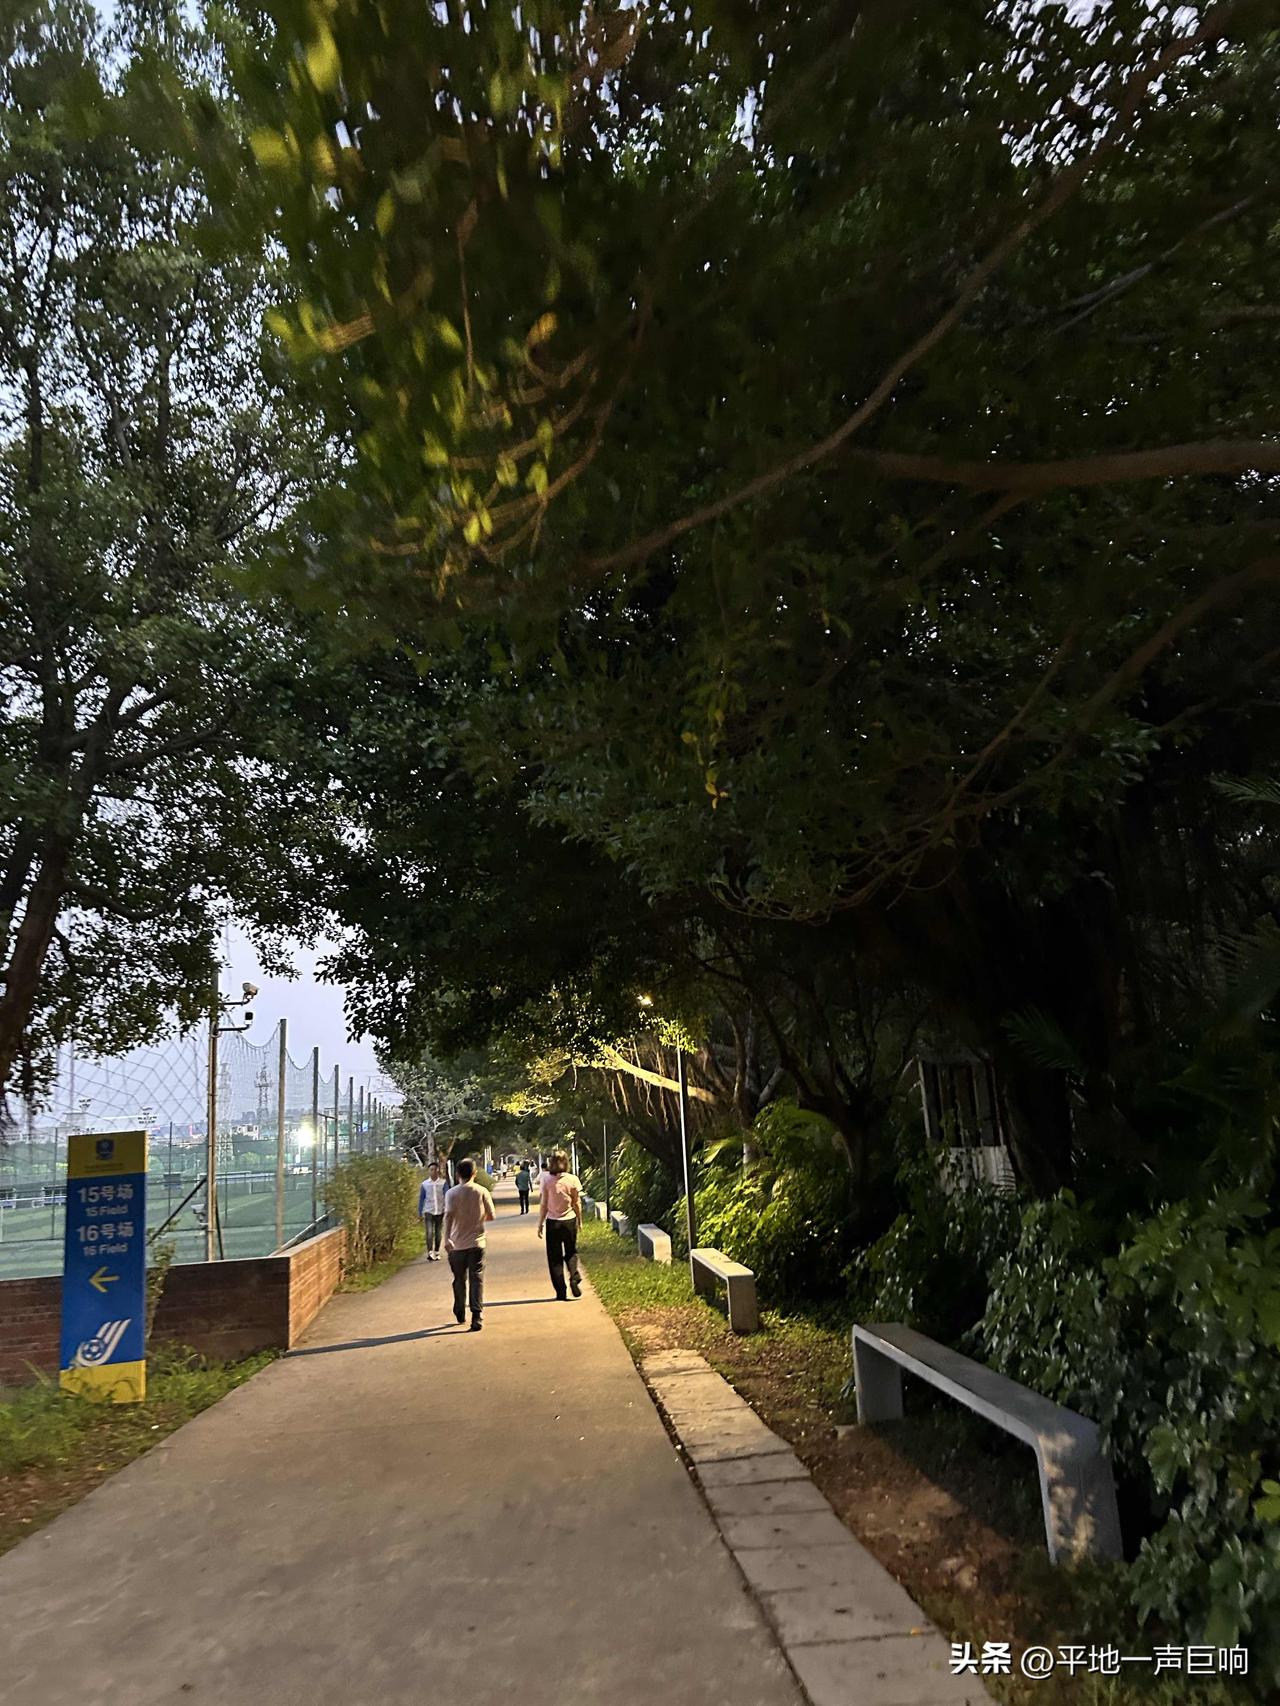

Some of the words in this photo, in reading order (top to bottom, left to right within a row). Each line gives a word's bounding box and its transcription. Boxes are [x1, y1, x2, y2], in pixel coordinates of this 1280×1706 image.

[78, 1184, 134, 1204] 15号场
[85, 1207, 98, 1217] 15
[99, 1205, 128, 1216] Field
[77, 1222, 134, 1242] 16号场
[99, 1243, 128, 1254] Field
